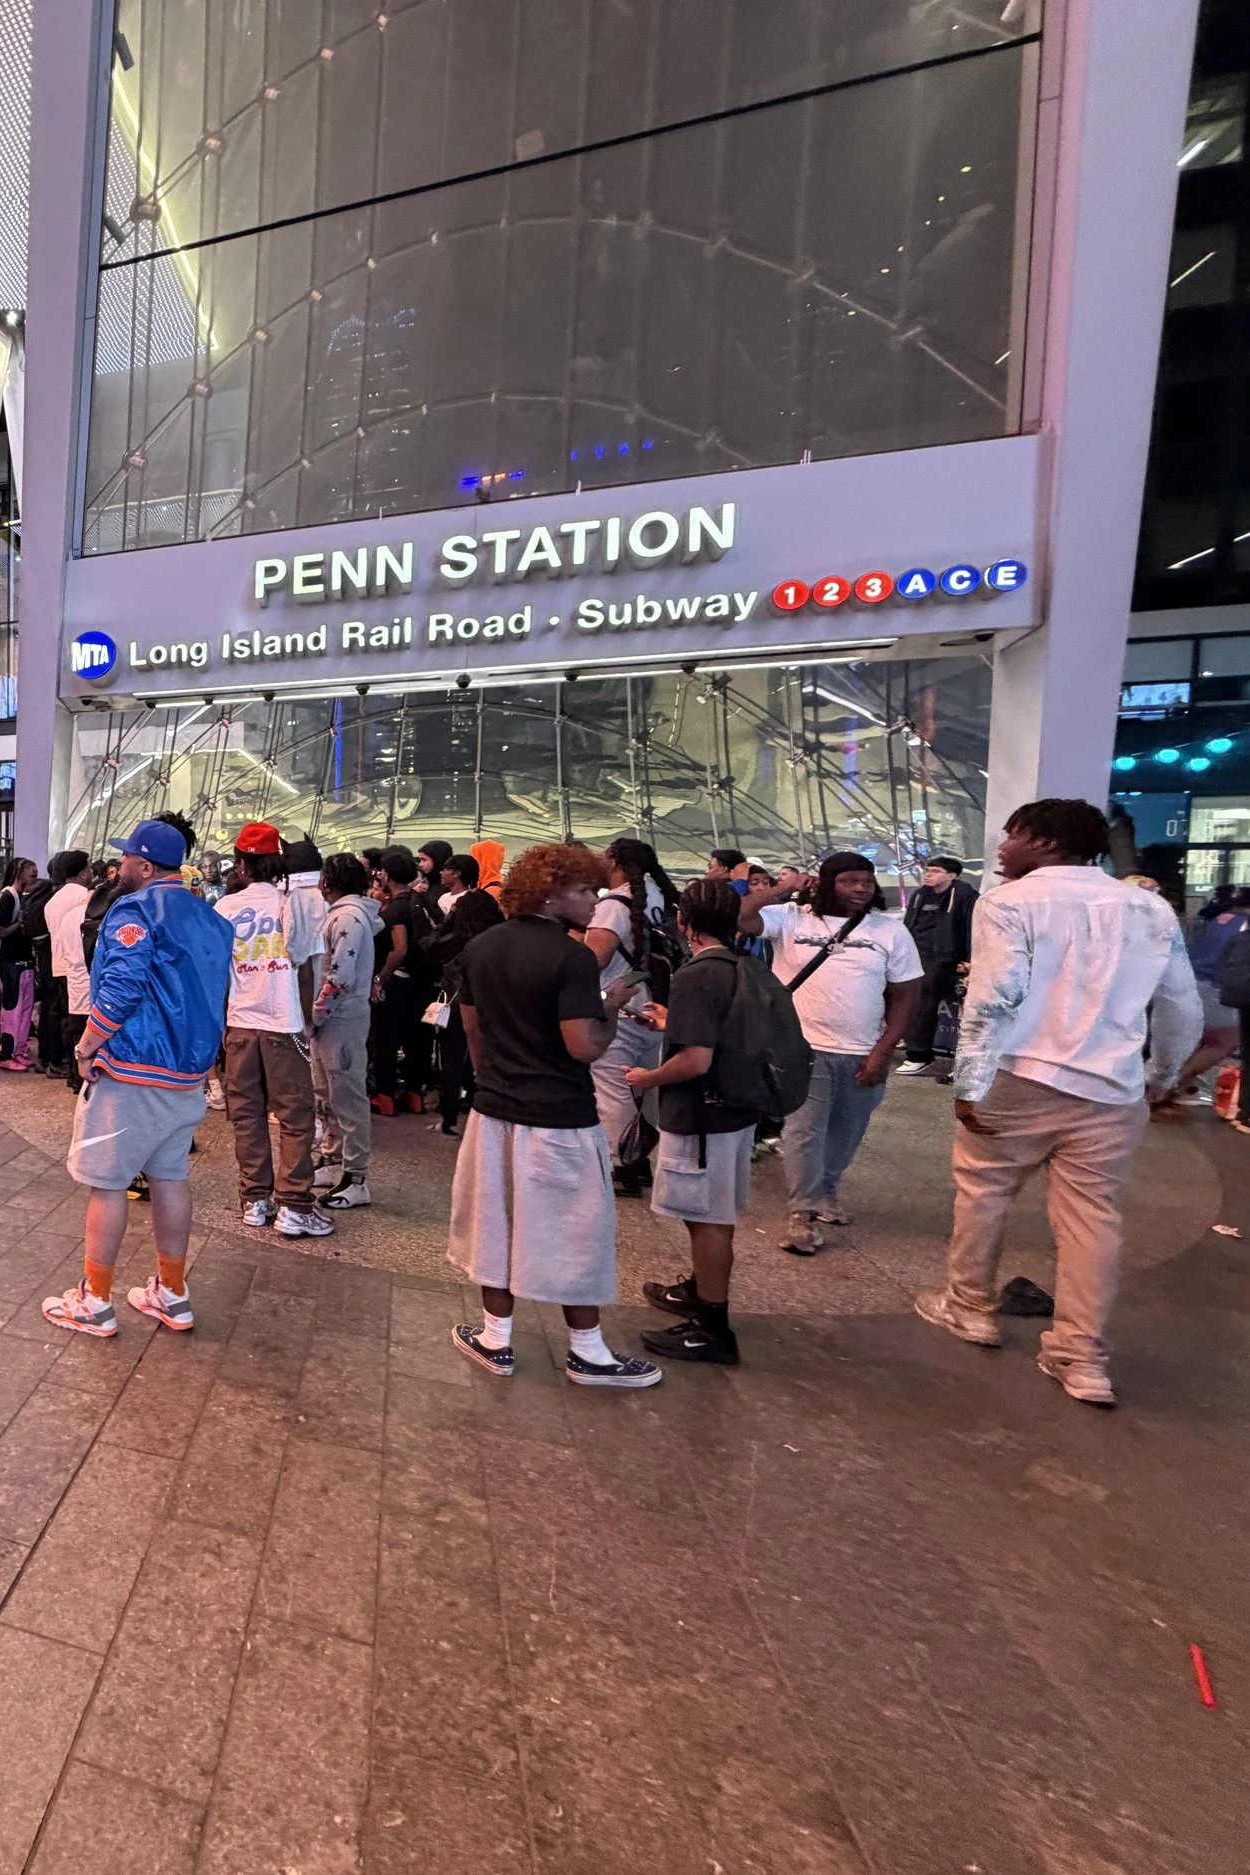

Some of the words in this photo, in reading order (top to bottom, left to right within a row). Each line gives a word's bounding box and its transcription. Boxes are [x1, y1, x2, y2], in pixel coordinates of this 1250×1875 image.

[254, 542, 414, 599] PENN
[439, 502, 736, 579] STATION
[71, 640, 111, 672] MTA
[129, 641, 208, 667] Long
[222, 624, 327, 659] Island
[342, 616, 413, 649] Rail
[428, 605, 532, 641] Road
[577, 591, 758, 629] Subway
[783, 585, 796, 604] 1
[822, 582, 840, 601] 2
[865, 577, 883, 597] 3
[904, 573, 928, 594] A
[949, 570, 971, 590] C
[996, 565, 1018, 585] E
